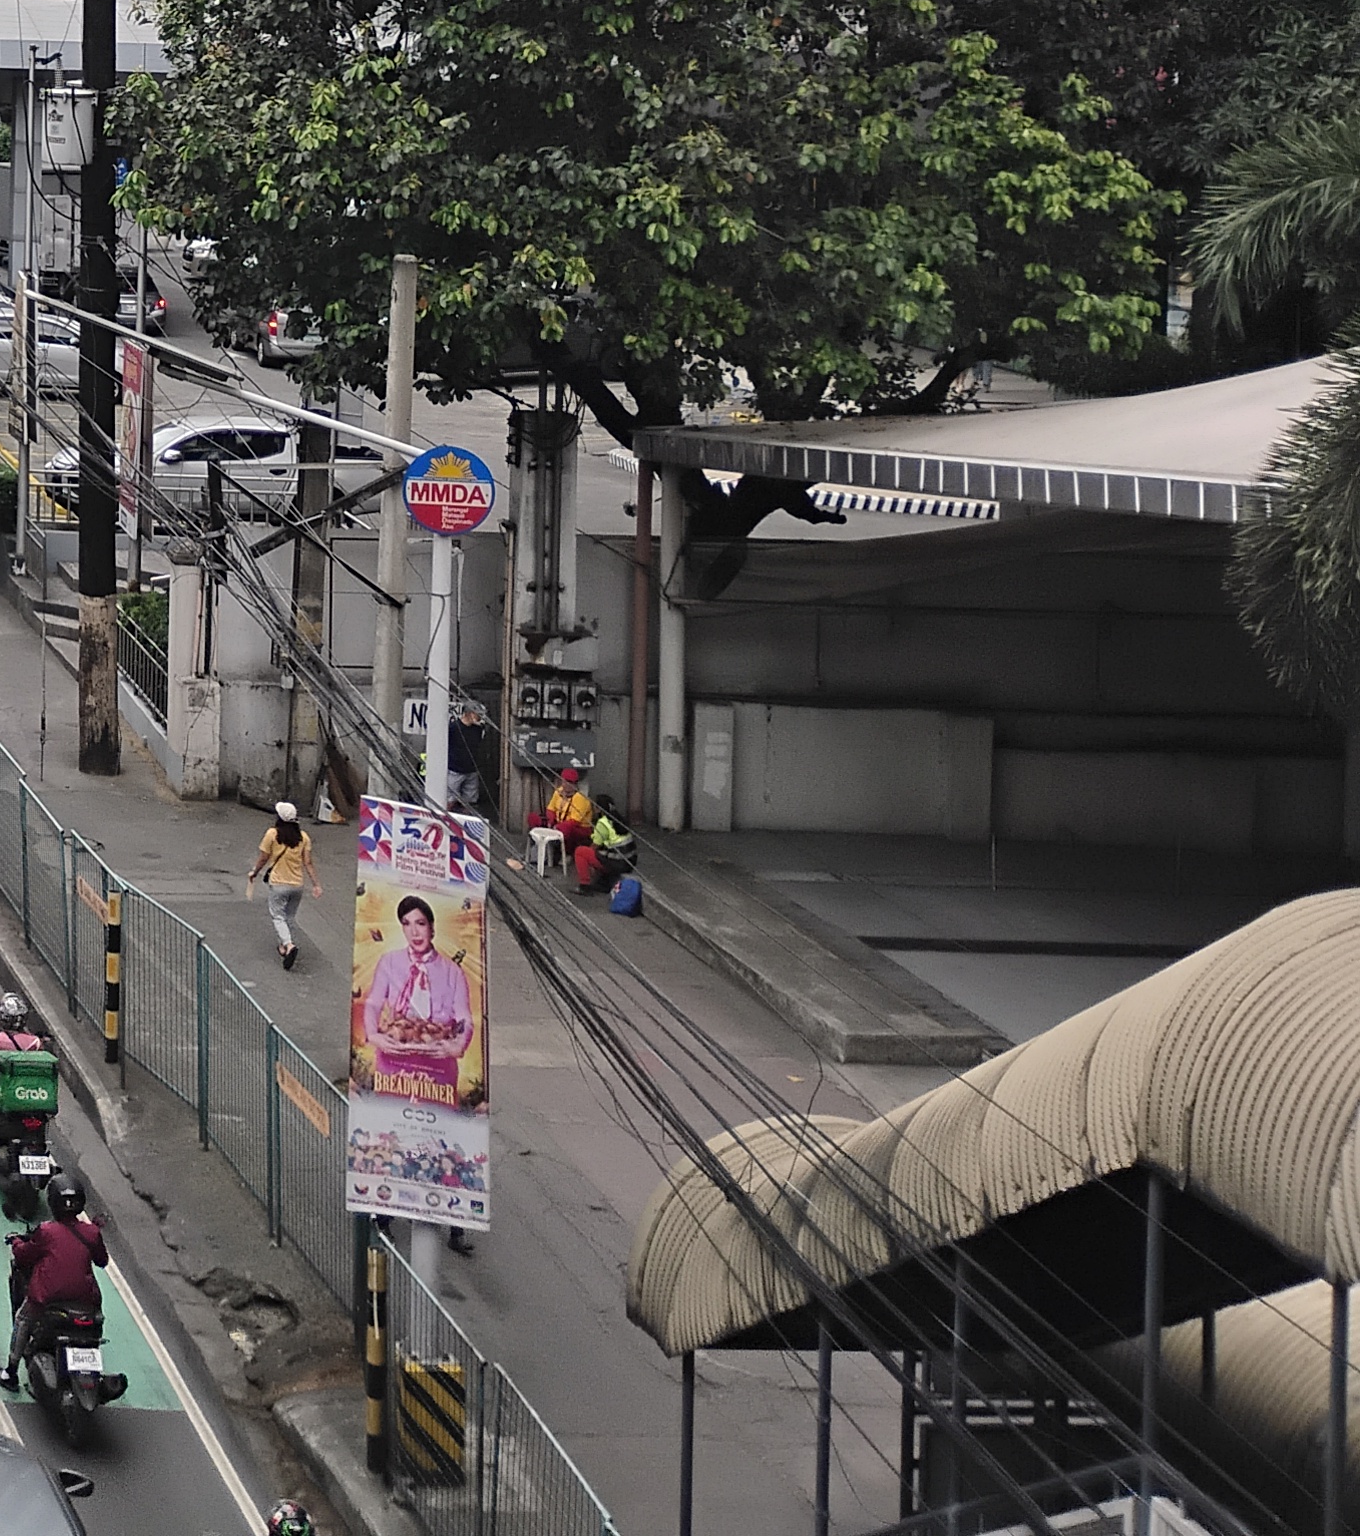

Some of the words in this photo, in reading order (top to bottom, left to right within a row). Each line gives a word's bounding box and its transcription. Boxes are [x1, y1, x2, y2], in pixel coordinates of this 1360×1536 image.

[411, 482, 487, 505] MMDA
[396, 854, 418, 865] Metro
[420, 860, 446, 871] Manila
[396, 862, 414, 872] Film
[415, 865, 446, 879] Festival
[15, 1086, 48, 1100] Grab
[374, 1071, 455, 1106] BREADWINNER
